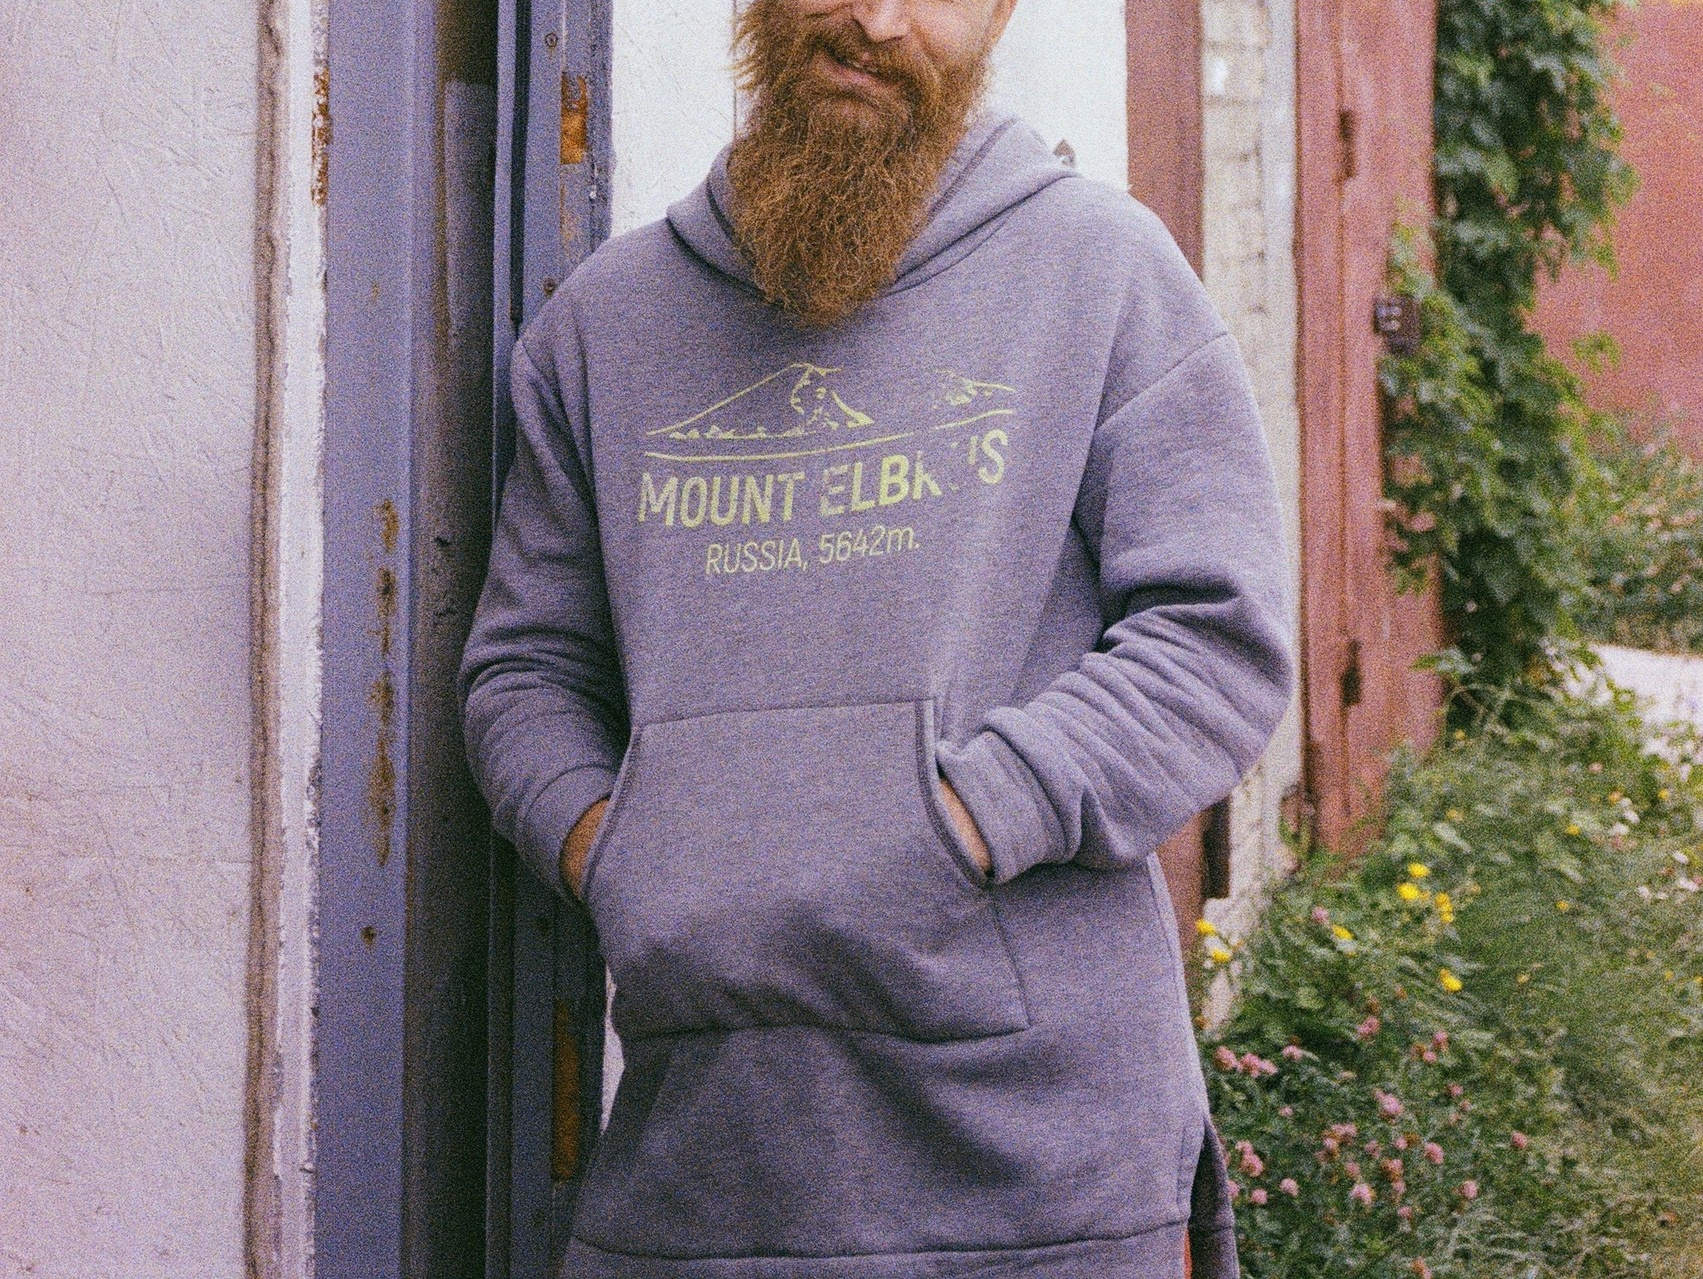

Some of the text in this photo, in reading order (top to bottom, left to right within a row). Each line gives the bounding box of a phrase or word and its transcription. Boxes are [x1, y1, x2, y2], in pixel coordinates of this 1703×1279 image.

[638, 471, 805, 528] MOUNT
[705, 524, 921, 575] RUSSIA, 5642m.
